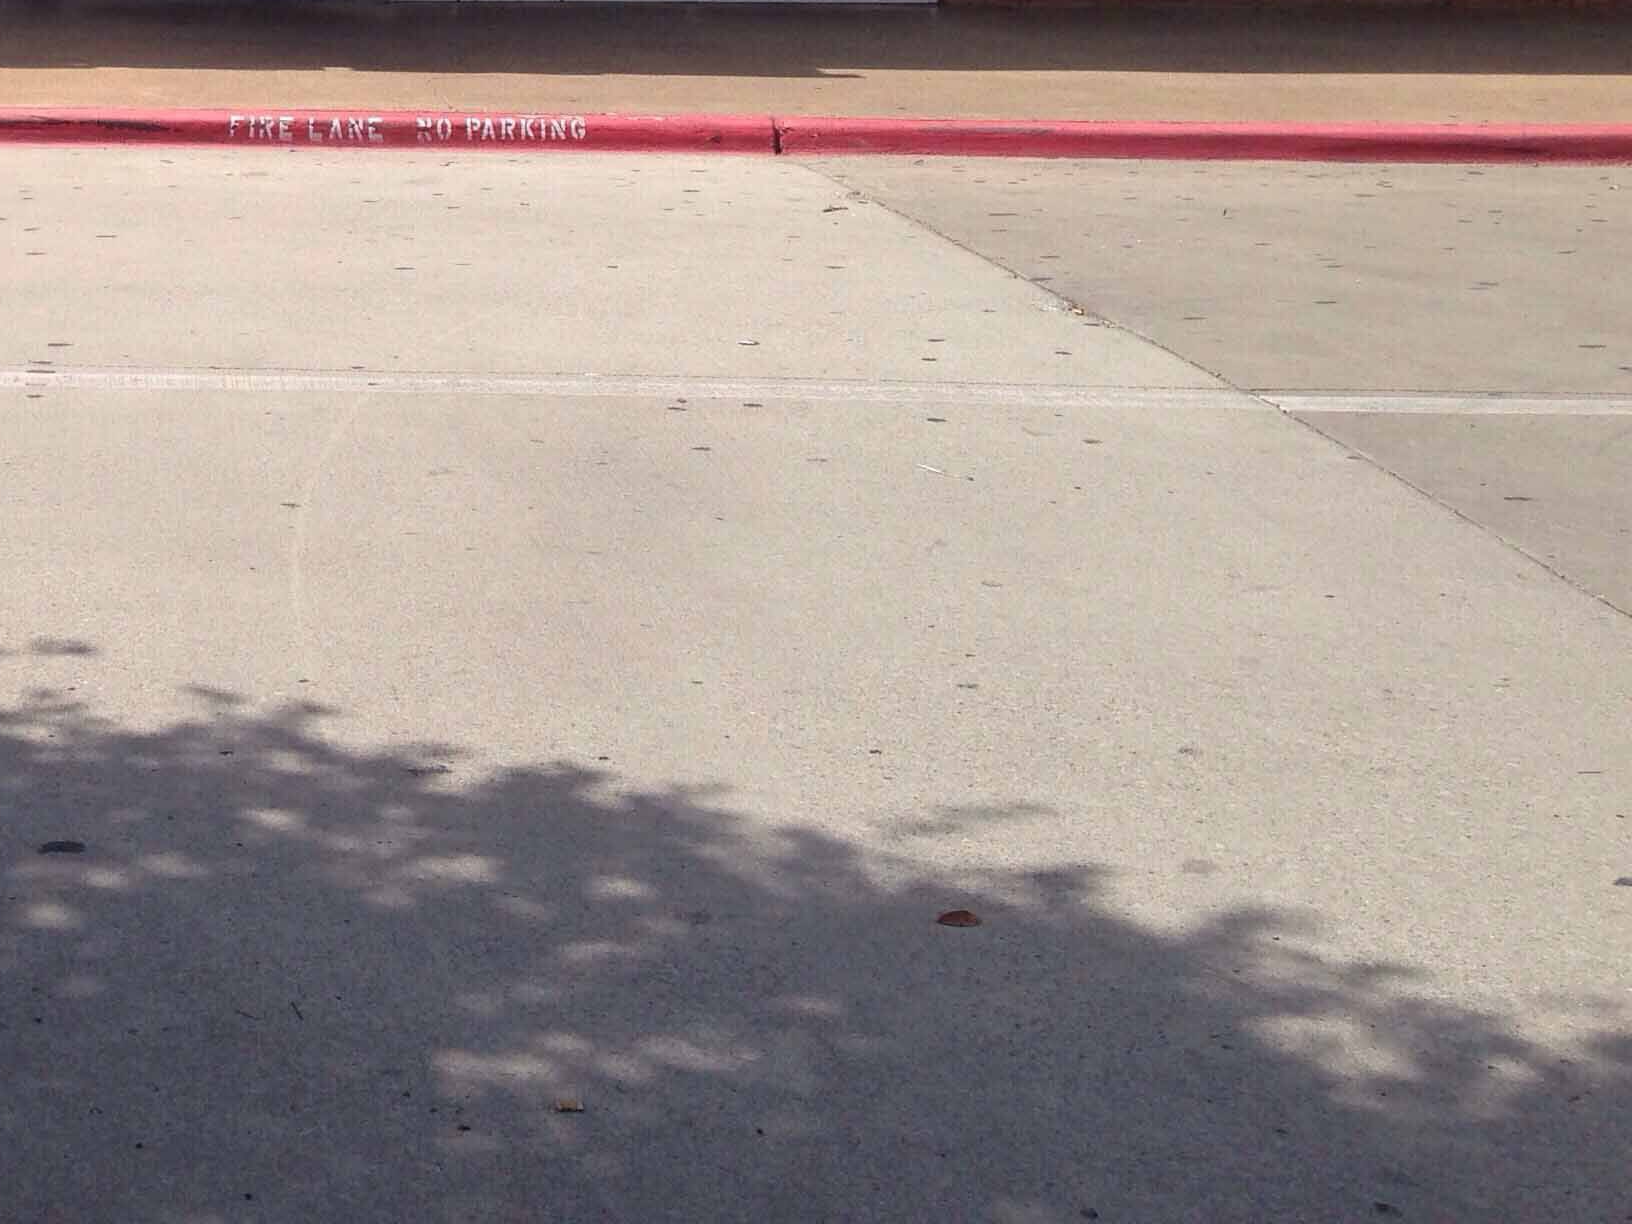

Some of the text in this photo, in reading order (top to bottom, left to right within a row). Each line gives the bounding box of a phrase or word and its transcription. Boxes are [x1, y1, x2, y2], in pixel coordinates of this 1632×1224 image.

[227, 114, 587, 143] FIRE LANE NO PARKING
